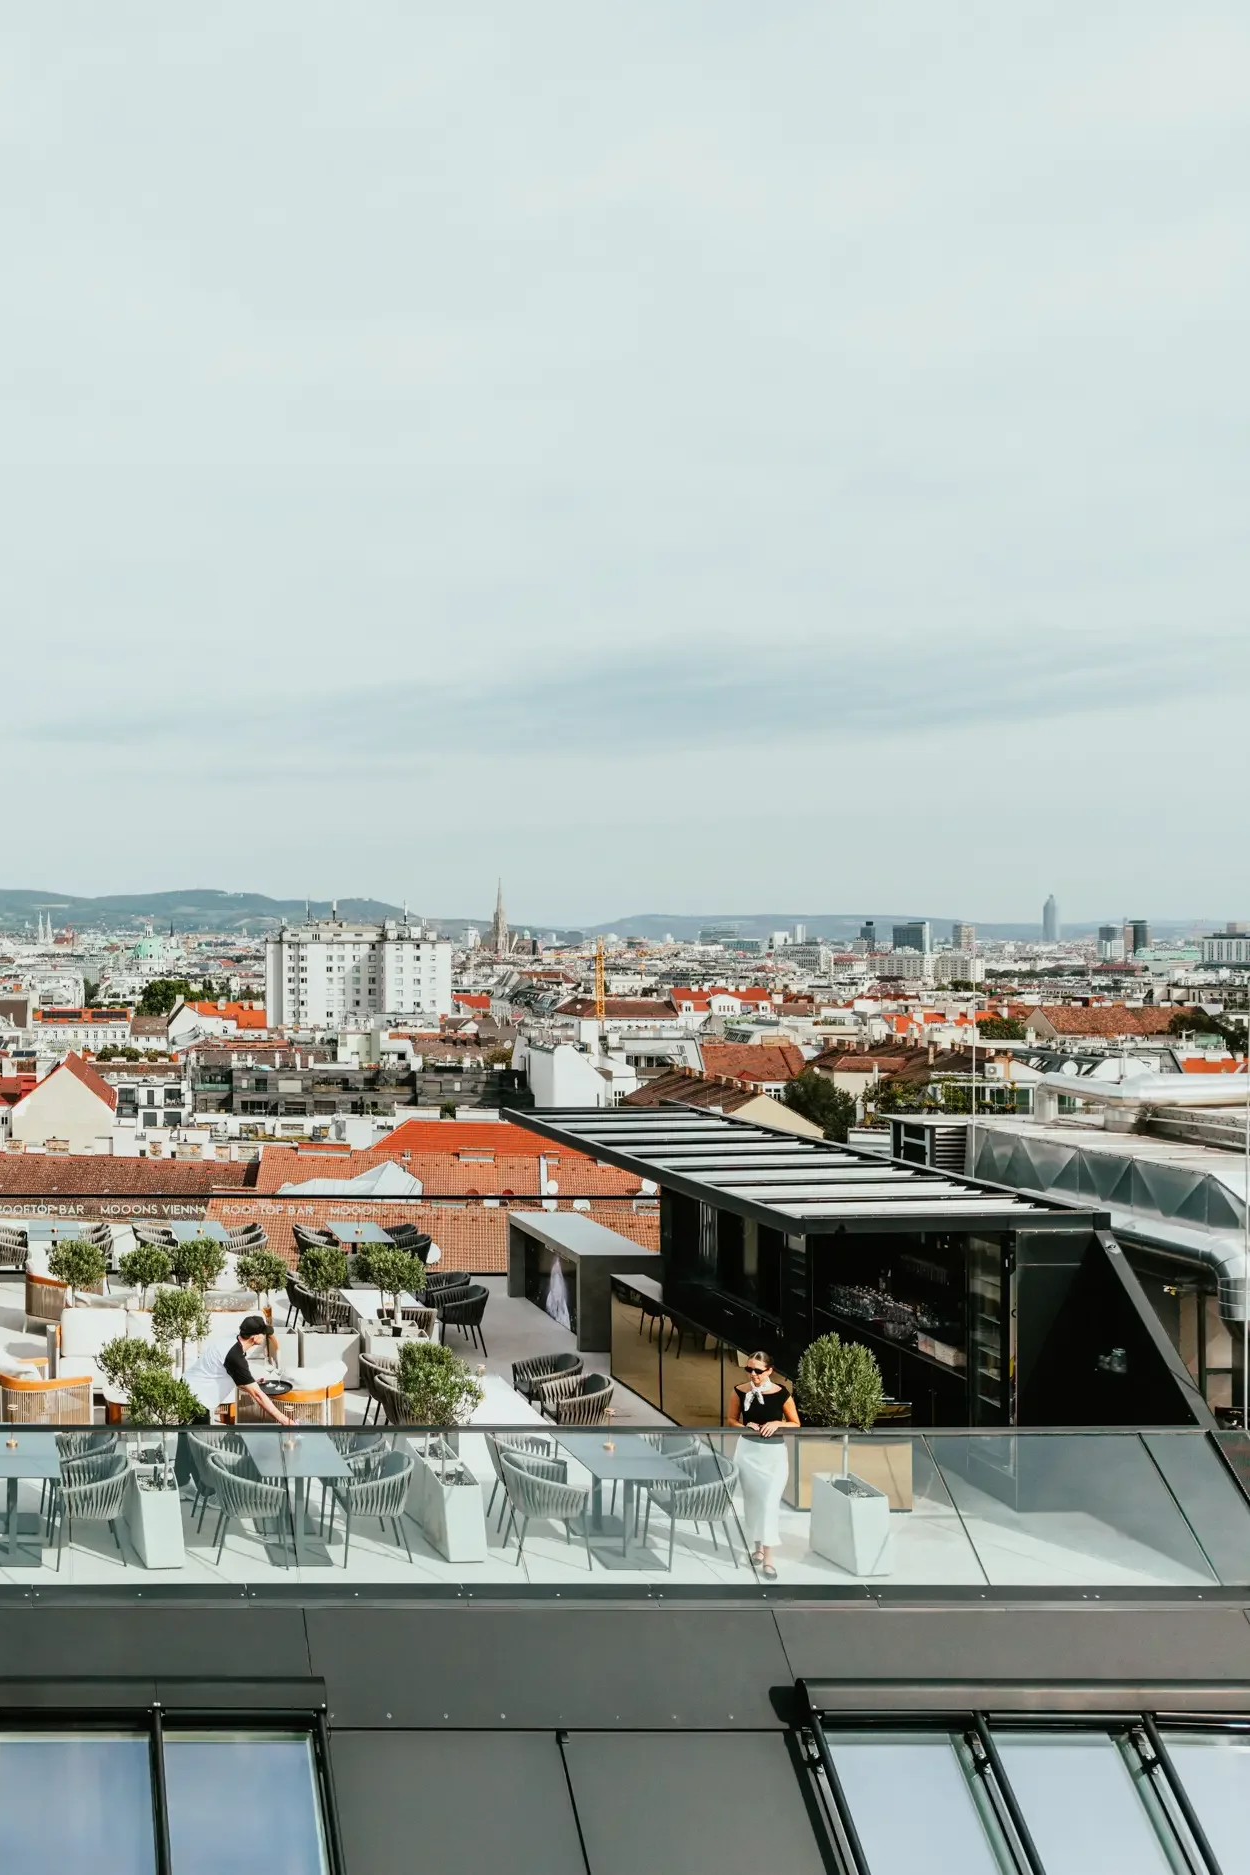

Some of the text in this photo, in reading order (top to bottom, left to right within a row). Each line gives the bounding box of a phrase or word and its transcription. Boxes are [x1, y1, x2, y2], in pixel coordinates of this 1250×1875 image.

[58, 1204, 85, 1215] BAR
[100, 1204, 158, 1215] MOOONS
[161, 1204, 207, 1215] VIENNA
[222, 1205, 283, 1216] ROOFTOP
[287, 1205, 314, 1216] BAR
[330, 1205, 387, 1216] MOOONS
